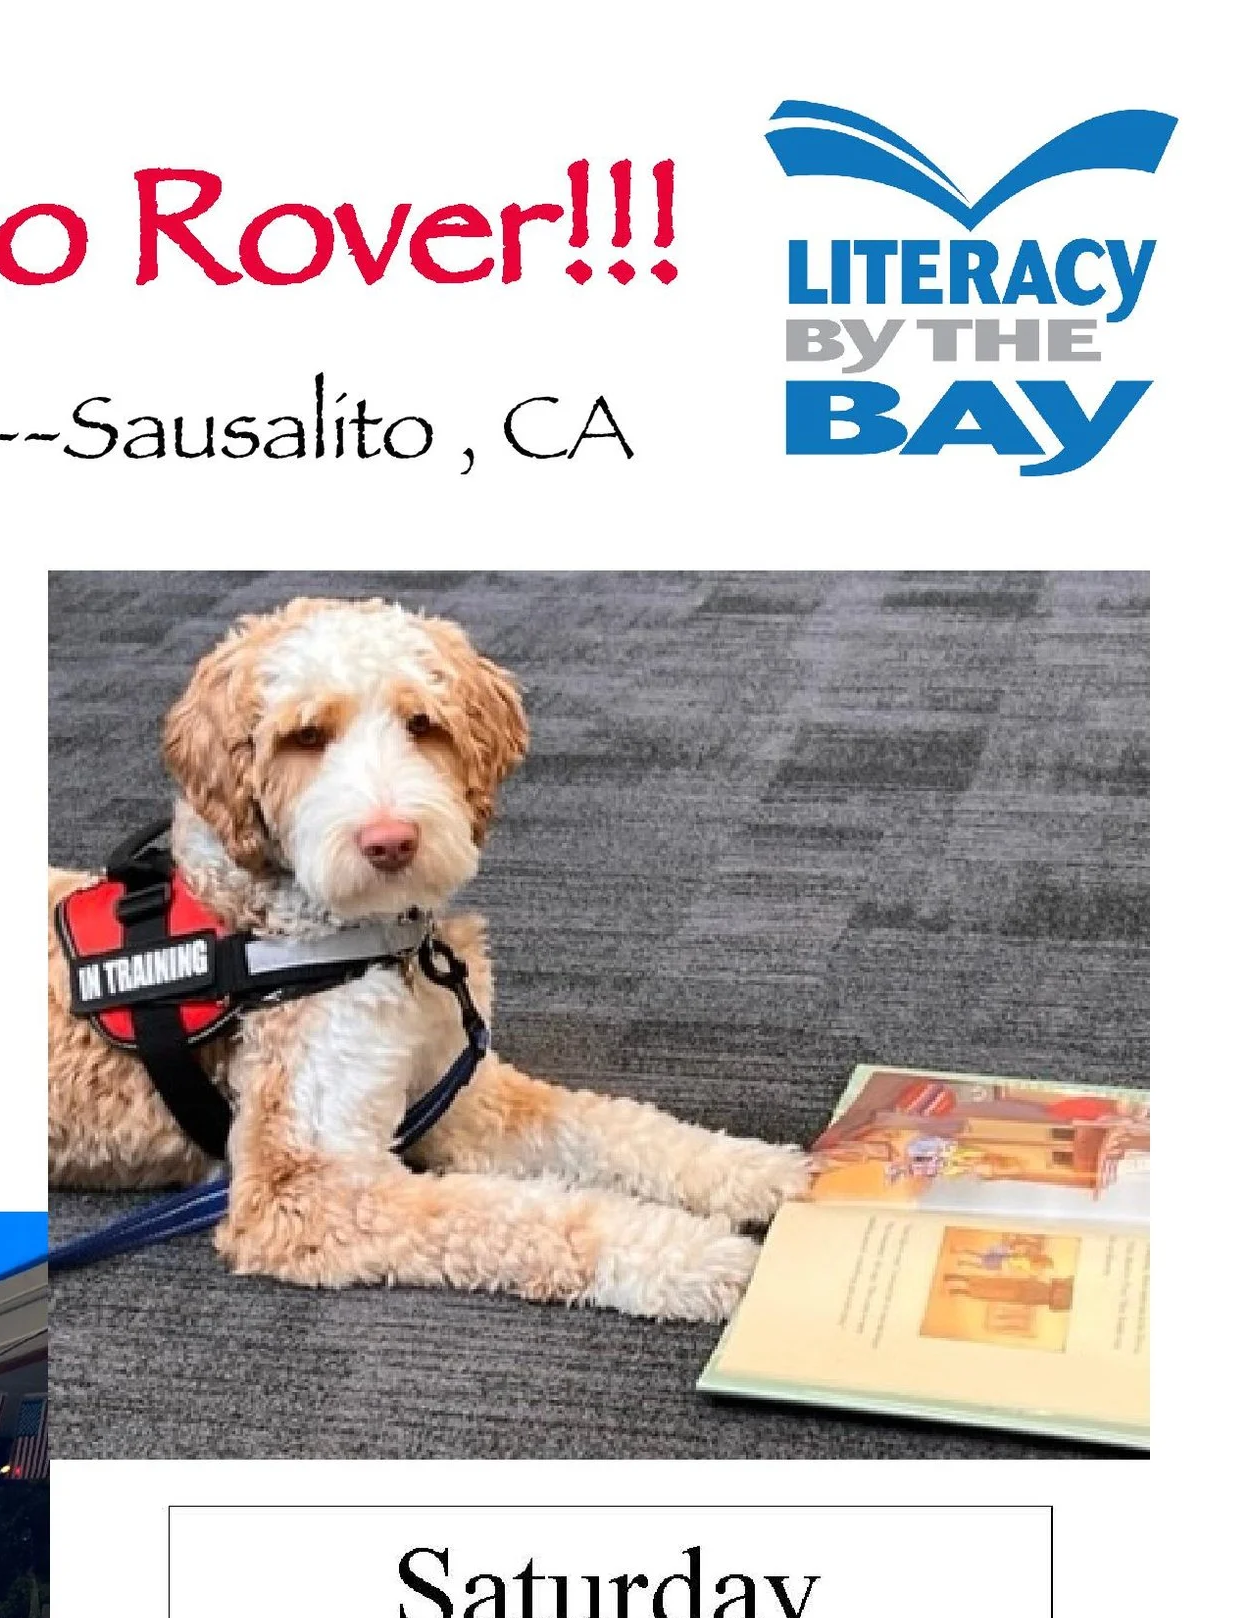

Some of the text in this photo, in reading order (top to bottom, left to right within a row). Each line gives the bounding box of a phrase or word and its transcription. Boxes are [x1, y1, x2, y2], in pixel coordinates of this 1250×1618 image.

[134, 159, 678, 285] Rover!!!
[917, 319, 1102, 361] THE
[504, 396, 634, 459] CA
[78, 940, 208, 1002] IN TRAINING
